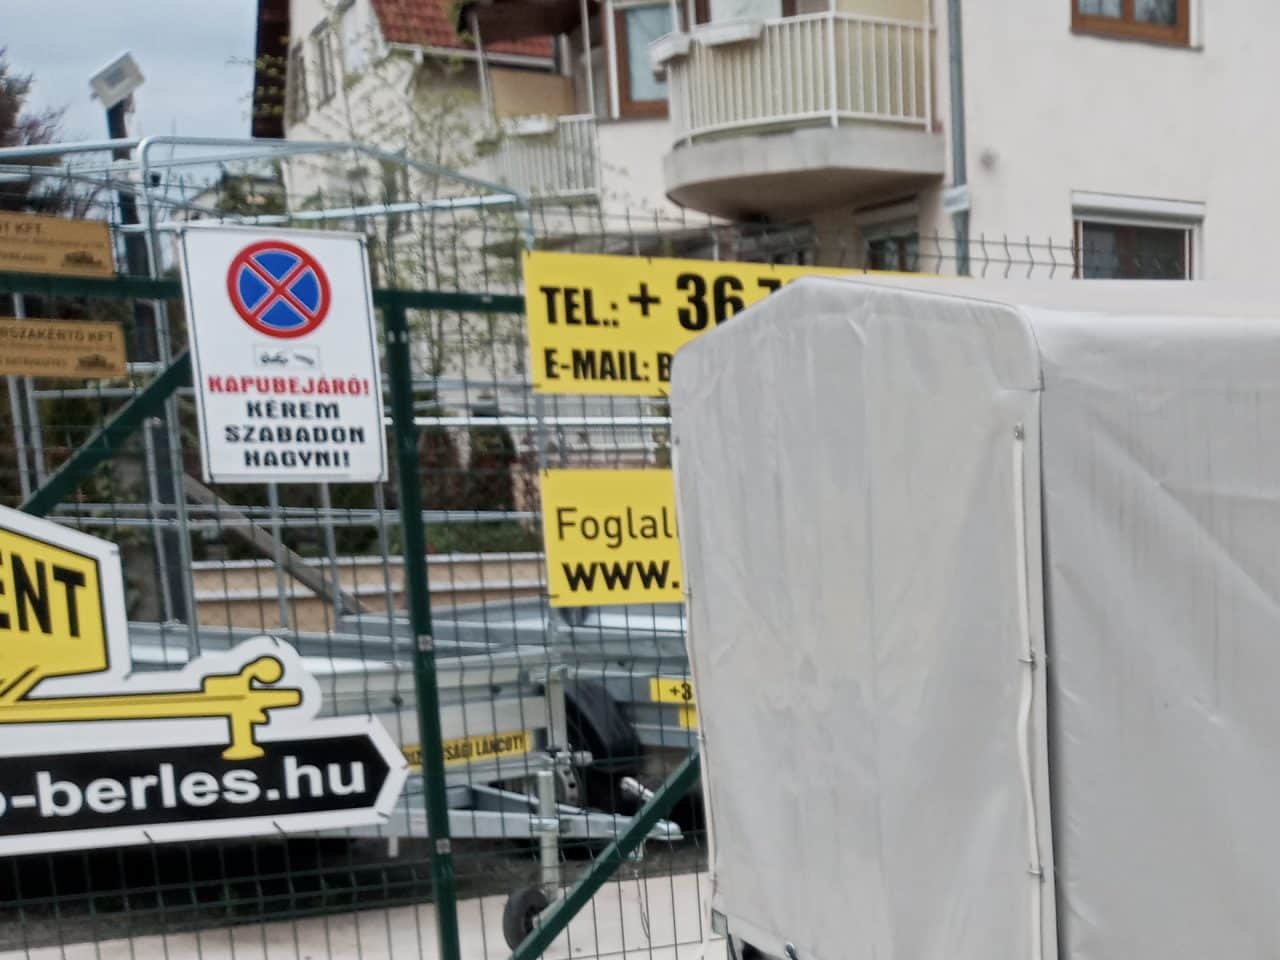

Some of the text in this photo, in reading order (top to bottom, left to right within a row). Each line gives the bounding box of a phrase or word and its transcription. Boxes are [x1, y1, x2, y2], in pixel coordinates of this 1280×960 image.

[540, 285, 620, 328] TEL.:
[544, 348, 651, 383] E-MAIL:
[208, 373, 370, 396] KAPUBEJÁRÓ!
[246, 398, 341, 420] KÉREM
[224, 425, 366, 444] SZABADON
[244, 449, 352, 468] HAGYNI!
[556, 506, 679, 549] Foglal
[561, 560, 681, 593] www.
[0, 755, 367, 818] -berles.hu
